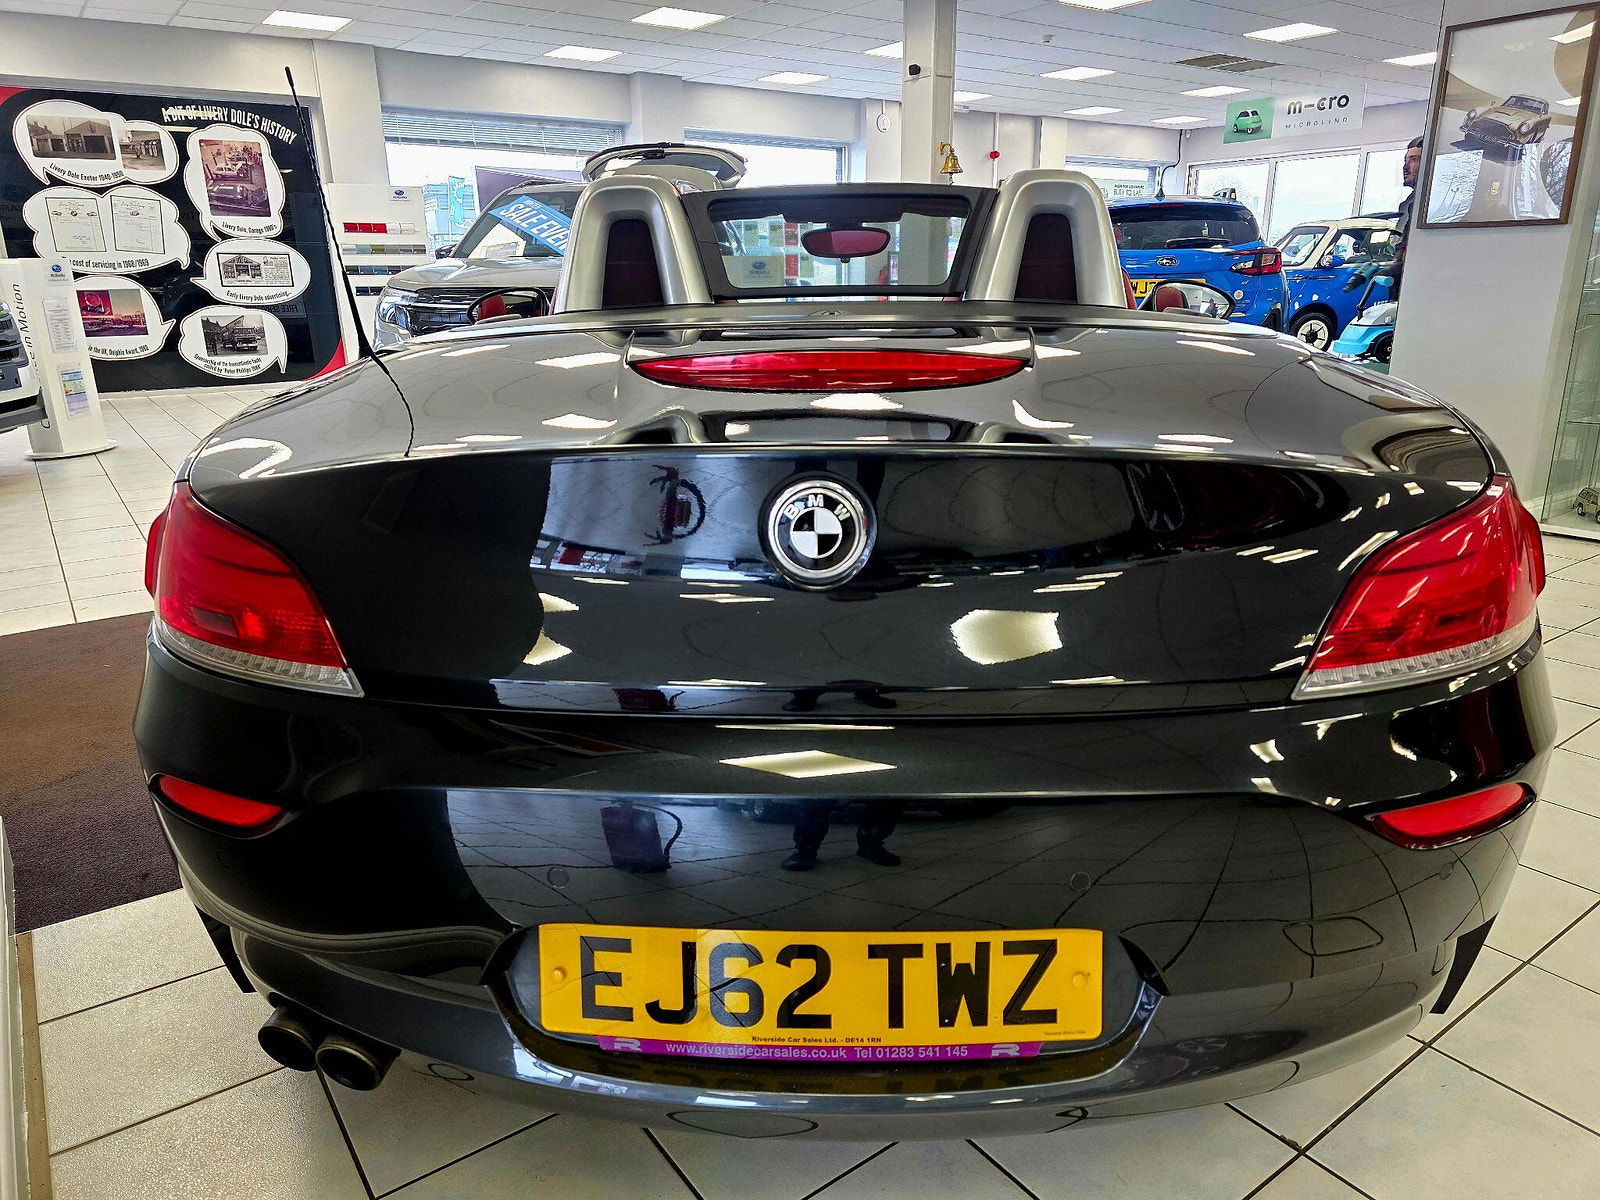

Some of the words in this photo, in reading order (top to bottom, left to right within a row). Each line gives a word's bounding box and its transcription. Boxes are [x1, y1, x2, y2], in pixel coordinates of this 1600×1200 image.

[198, 105, 229, 121] LIVERY
[231, 108, 260, 128] DOLE'S
[261, 117, 297, 145] HISTORY
[1285, 117, 1348, 129] MICROLINO
[49, 162, 66, 176] Livery
[67, 170, 80, 179] Dole
[499, 203, 548, 228] SALE
[222, 222, 236, 232] Livery
[249, 227, 264, 235] Garage
[92, 261, 117, 270] servicing
[116, 261, 122, 269] in
[226, 290, 238, 300] Early
[239, 293, 253, 302] Livery
[13, 284, 30, 333] Motion
[24, 337, 33, 348] in
[101, 348, 109, 356] UK,
[109, 348, 125, 356] Dolphin
[194, 353, 217, 366] Sponsorship
[236, 366, 251, 374] Phillips
[783, 494, 850, 520] BMW
[579, 935, 832, 1029] EJ62
[867, 939, 1058, 1029] TWZ
[666, 1042, 846, 1058] www.riversidecarsales.co.uk
[854, 1046, 872, 1058] Tel
[876, 1046, 915, 1058] 01283
[918, 1046, 940, 1057] 541
[946, 1046, 968, 1057] 145
